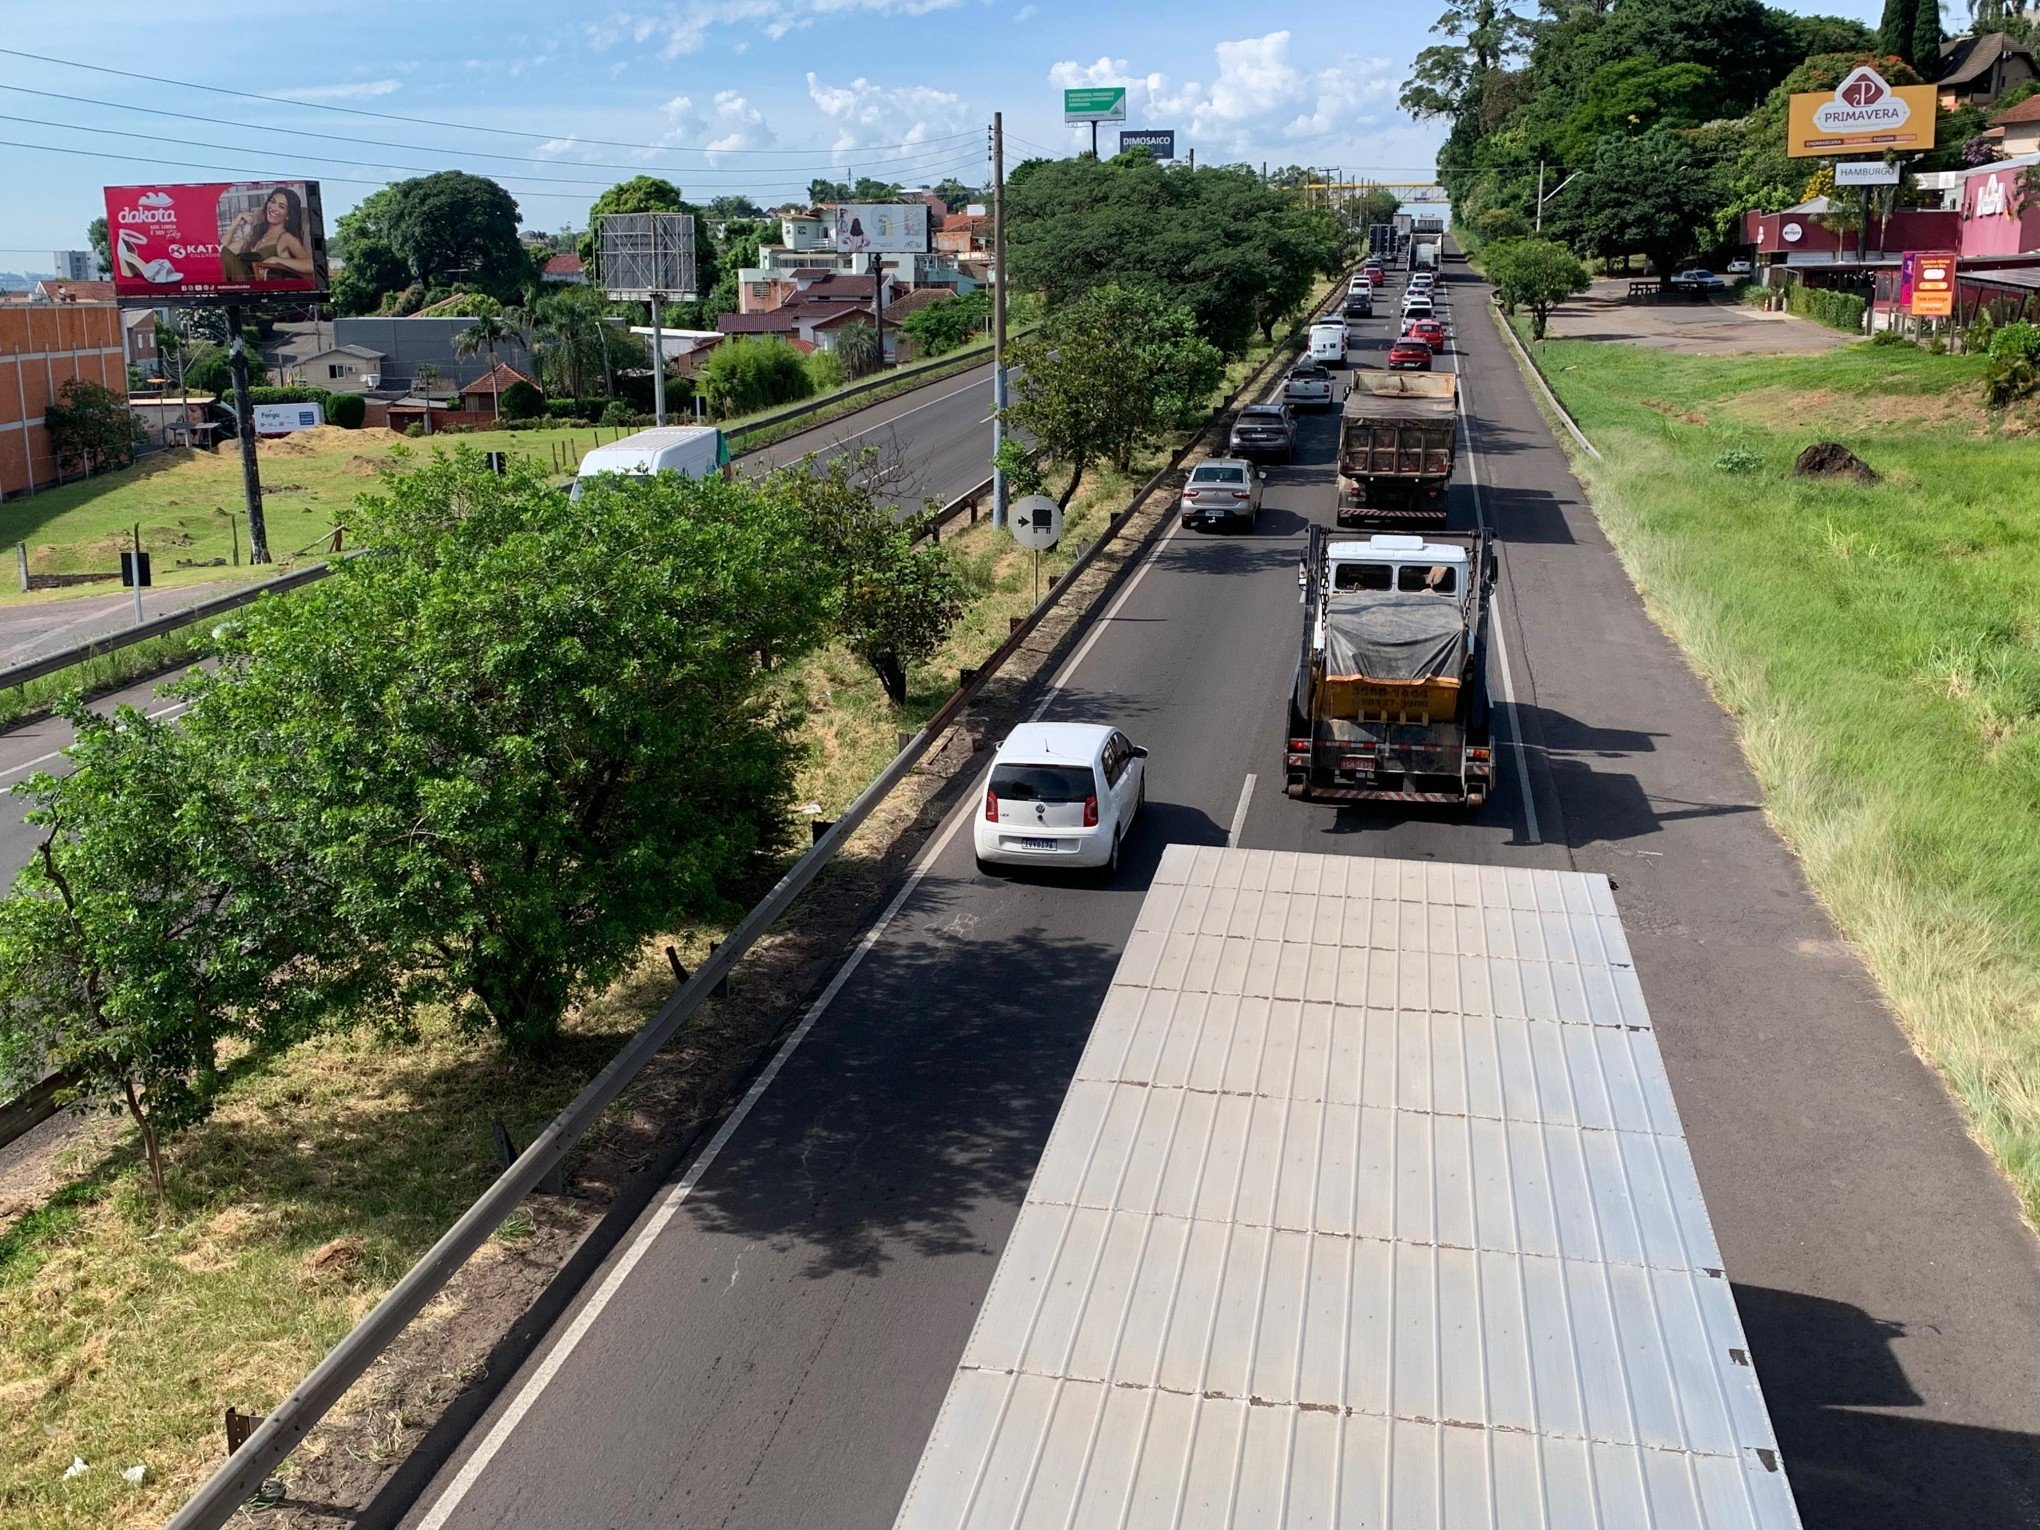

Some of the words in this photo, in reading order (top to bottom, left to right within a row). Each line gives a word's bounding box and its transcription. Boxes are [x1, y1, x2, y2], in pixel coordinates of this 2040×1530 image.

[1824, 108, 1899, 122] PRIMAVERA
[1123, 136, 1171, 146] DIMOSAICO
[1840, 167, 1895, 177] HAMBURGO
[118, 207, 176, 223] dakota
[186, 244, 224, 254] KATY
